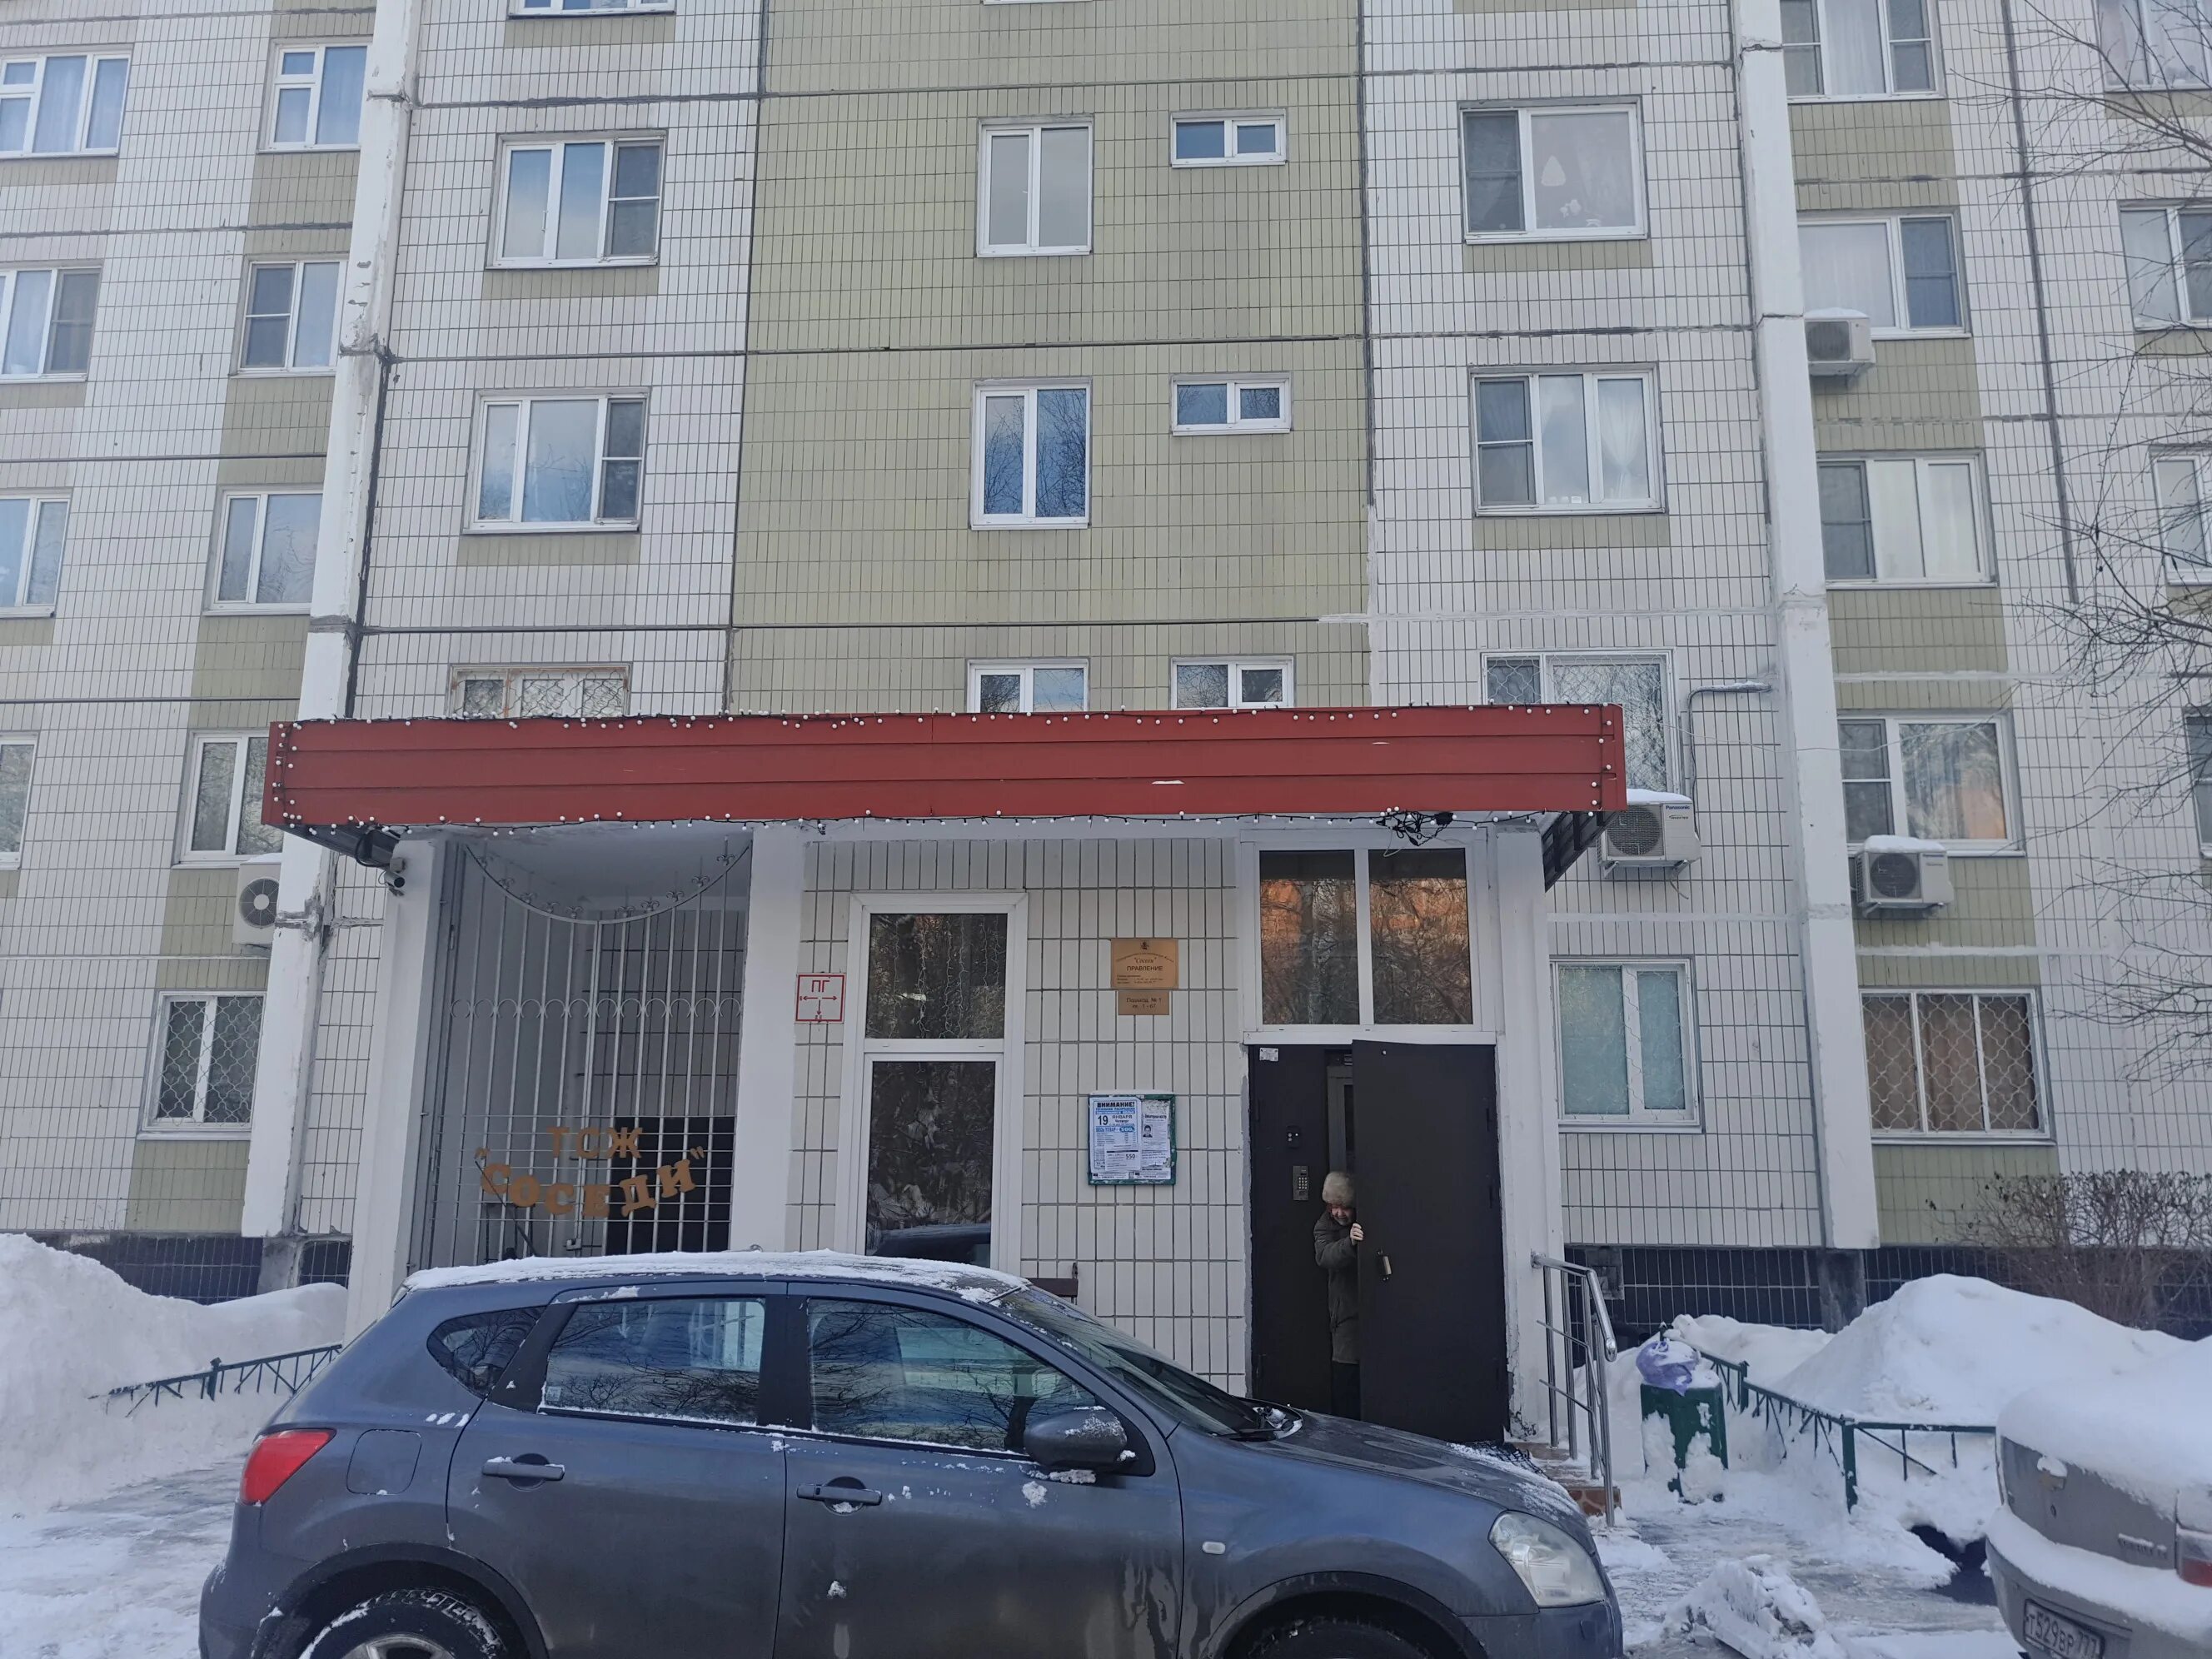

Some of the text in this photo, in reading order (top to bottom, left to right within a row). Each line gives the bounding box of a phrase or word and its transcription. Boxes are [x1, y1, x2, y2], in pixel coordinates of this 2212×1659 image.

[811, 979, 830, 993] ПГ
[1097, 1115, 1108, 1125] 19
[546, 1126, 643, 1159] ТСЖ
